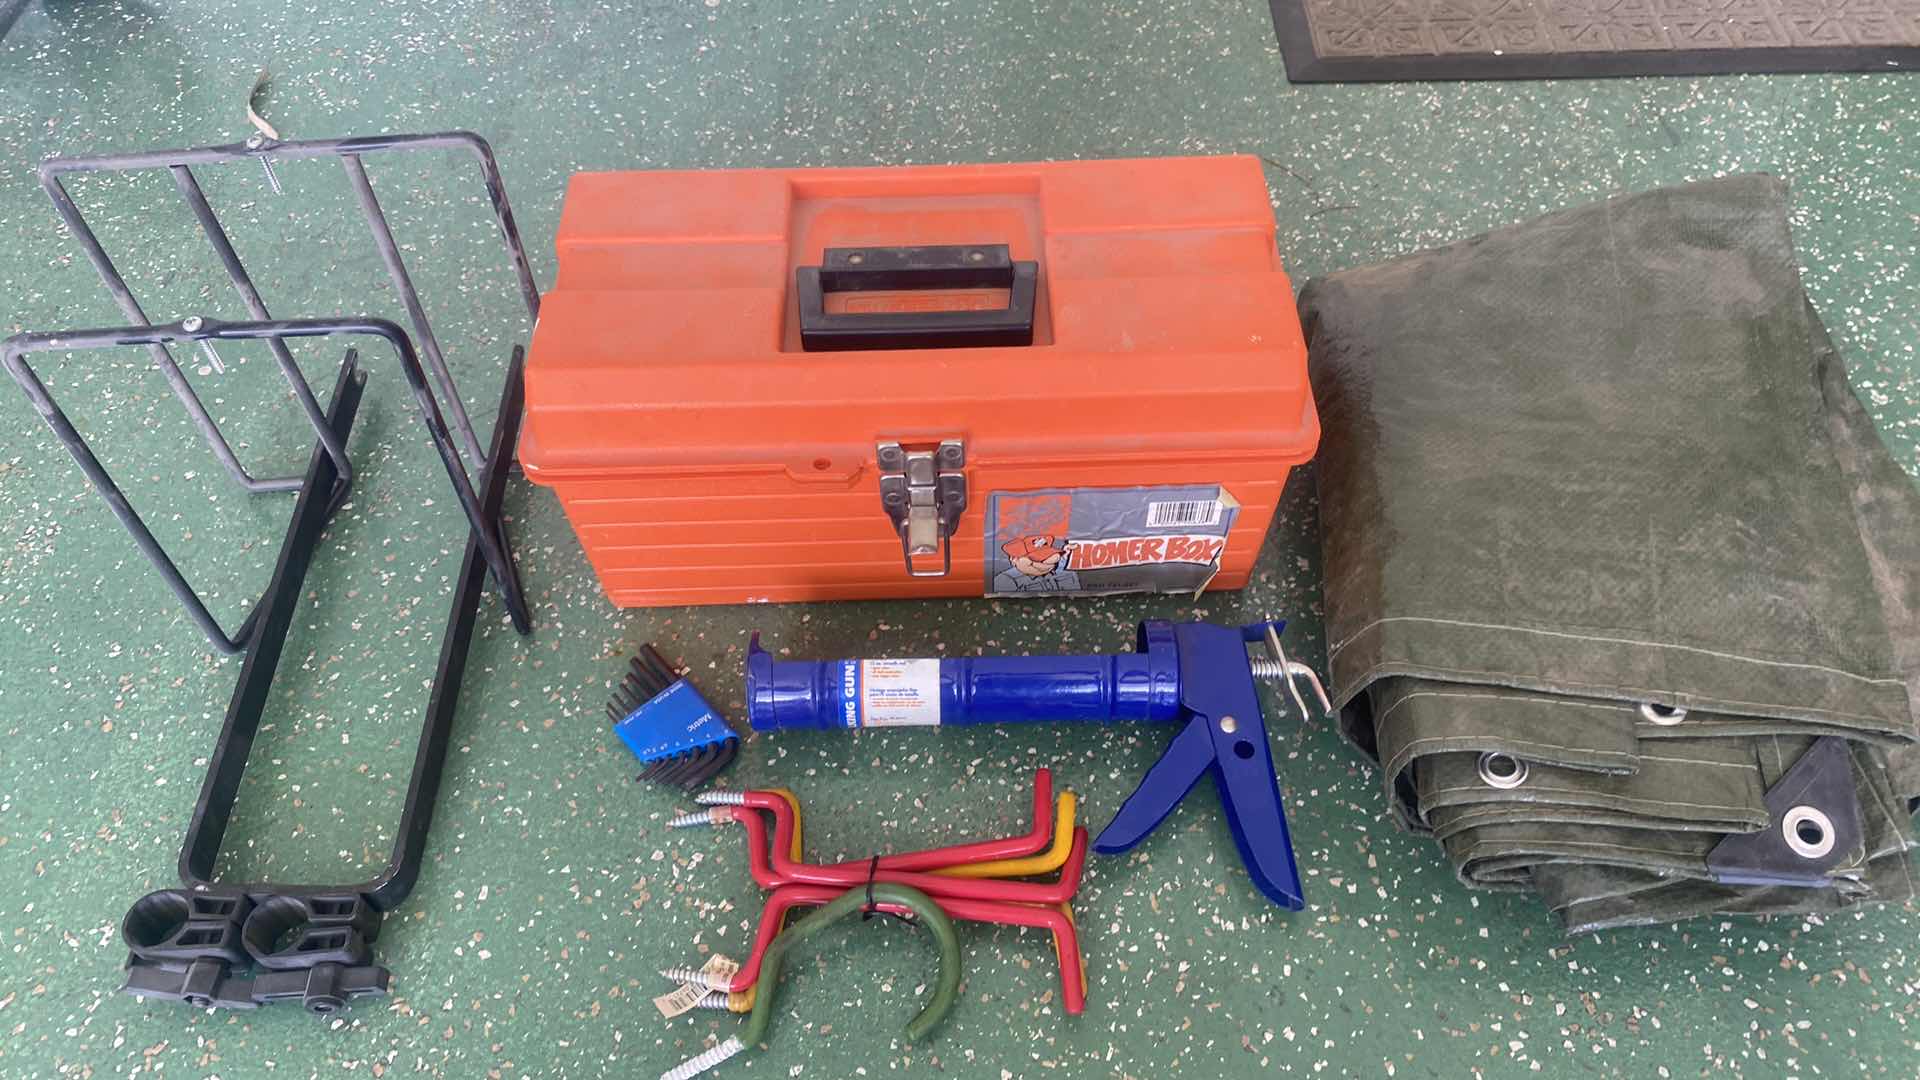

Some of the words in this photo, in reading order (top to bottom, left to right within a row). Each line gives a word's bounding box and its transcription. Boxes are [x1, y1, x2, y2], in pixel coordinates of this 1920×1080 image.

[1070, 538, 1164, 569] HOMER
[1164, 536, 1224, 562] BOX
[686, 712, 712, 732] Metric
